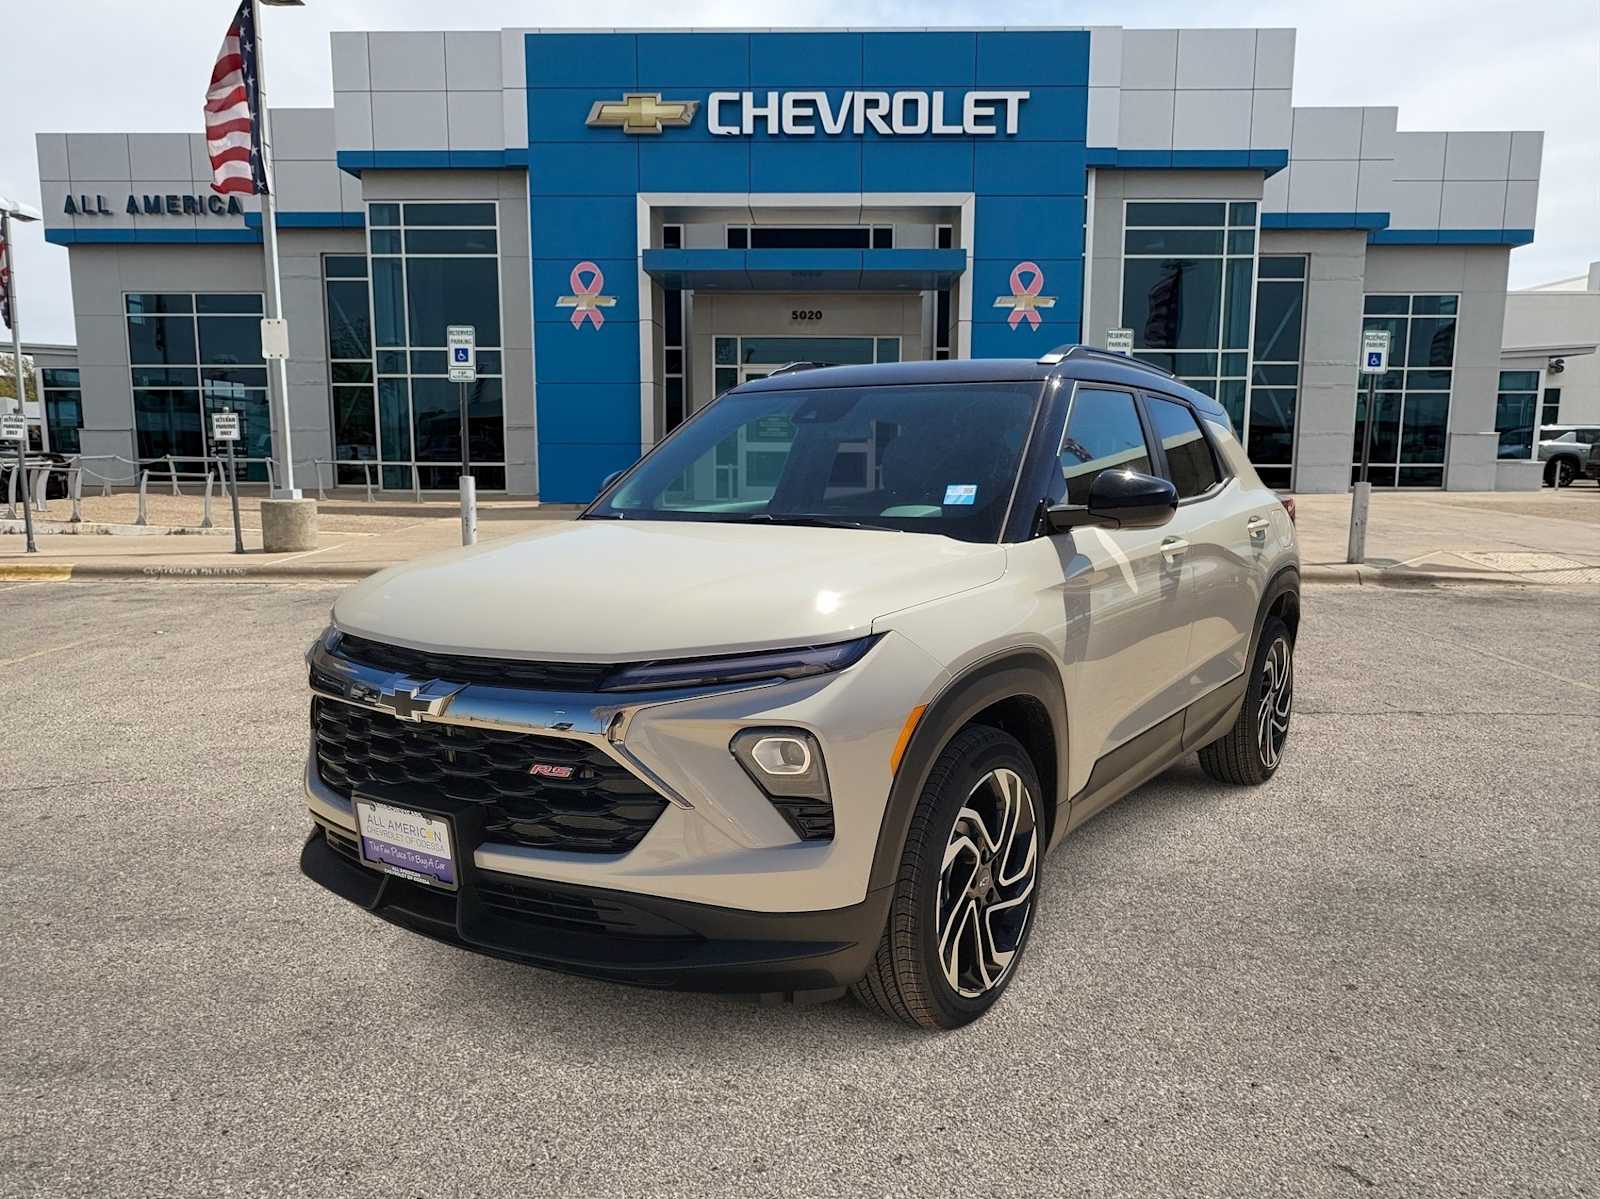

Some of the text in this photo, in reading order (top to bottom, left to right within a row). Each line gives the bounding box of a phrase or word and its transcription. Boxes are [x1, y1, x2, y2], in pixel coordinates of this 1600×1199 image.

[707, 91, 1031, 136] CHEVROLET
[64, 194, 112, 216] ALL
[791, 310, 823, 320] 5020
[529, 764, 573, 778] RS
[366, 814, 384, 827] ALL
[390, 847, 406, 860] Place
[406, 851, 414, 862] To
[414, 854, 428, 868] Buy
